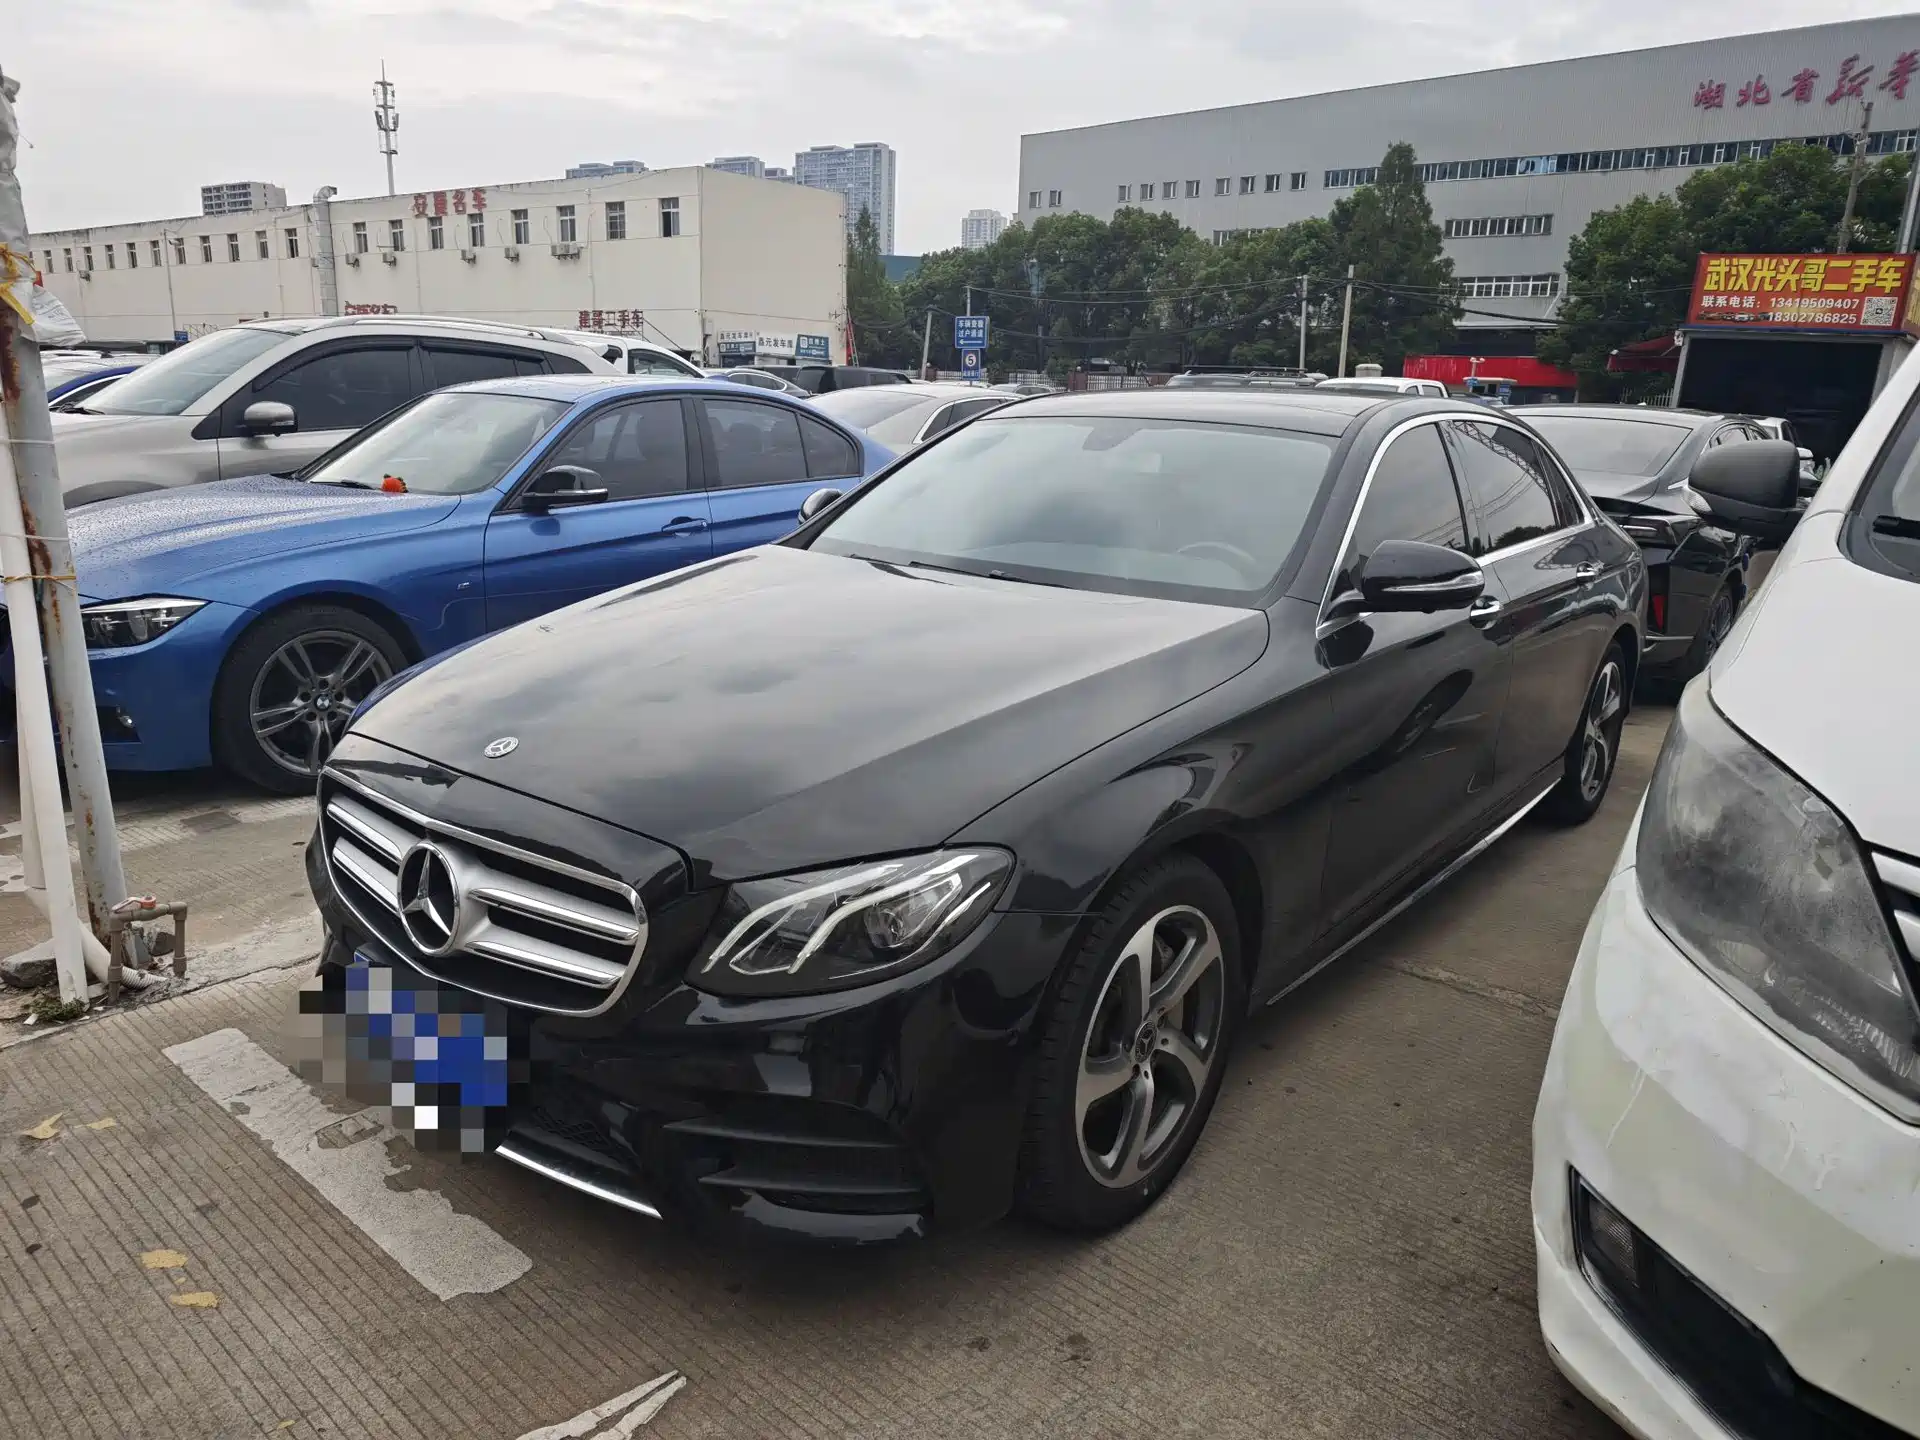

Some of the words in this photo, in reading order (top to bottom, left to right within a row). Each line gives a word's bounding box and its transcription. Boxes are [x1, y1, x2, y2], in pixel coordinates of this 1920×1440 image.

[1703, 257, 1905, 293] 武汉光头哥二手车
[1770, 298, 1860, 309] 13419509407
[579, 309, 644, 329] 建哥二手车
[1768, 311, 1857, 324] 18302786825
[968, 355, 974, 365] 5
